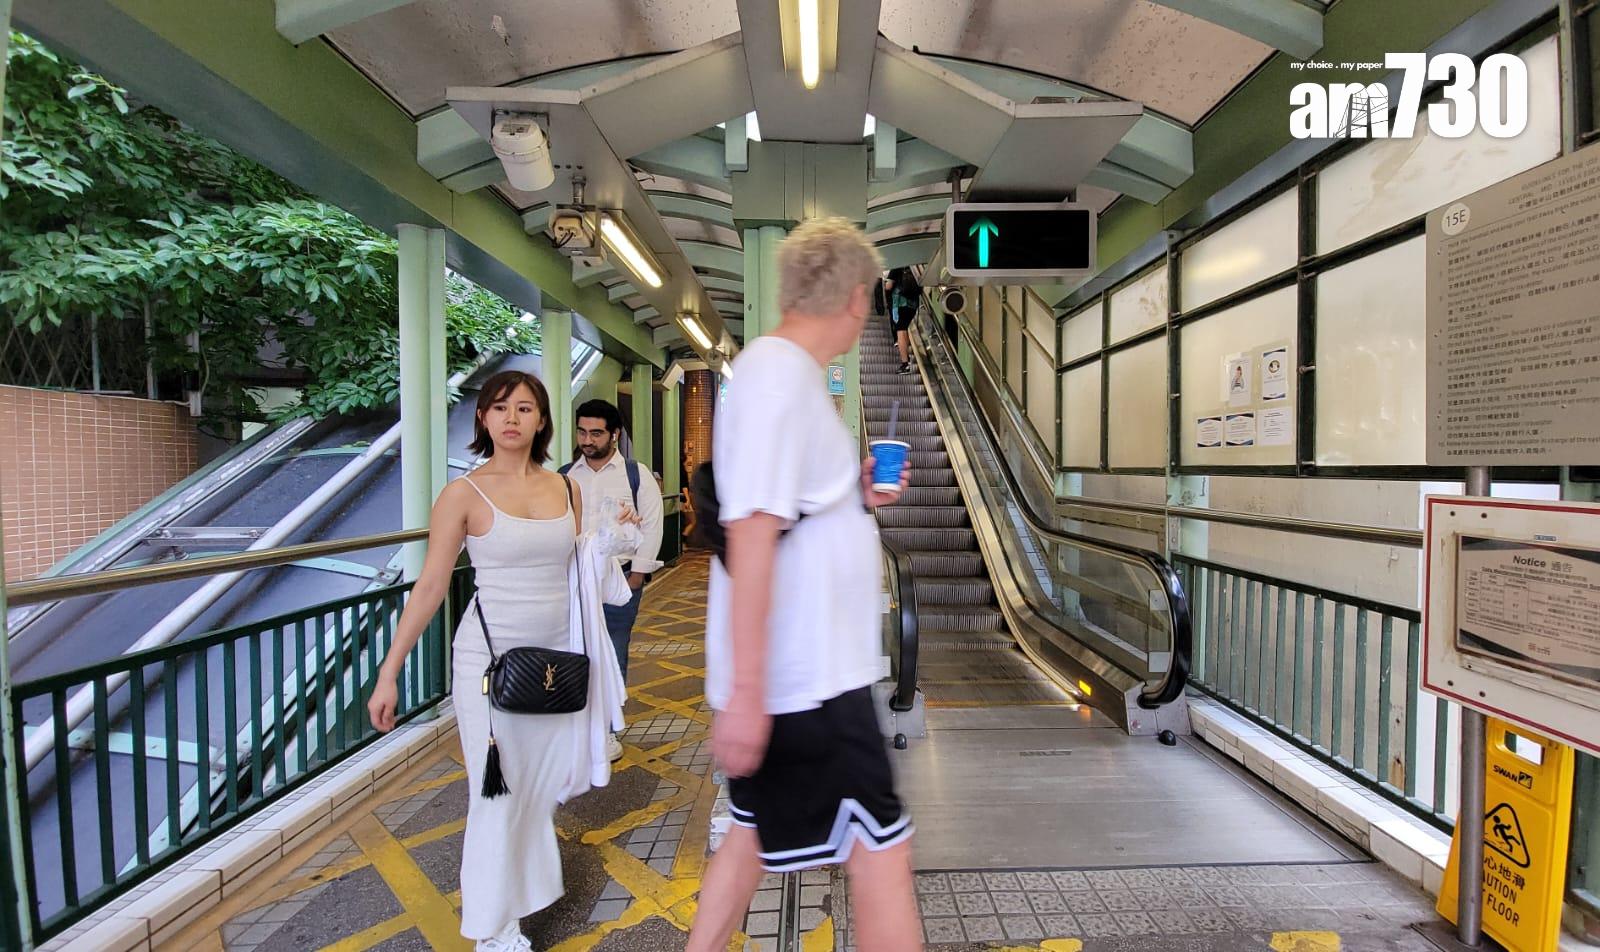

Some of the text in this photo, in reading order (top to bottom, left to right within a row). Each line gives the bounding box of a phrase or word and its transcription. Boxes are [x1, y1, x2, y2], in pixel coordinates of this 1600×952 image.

[1445, 209, 1466, 227] 15E
[1512, 555, 1546, 568] Notice
[1493, 764, 1518, 782] SWAN
[1484, 855, 1526, 891] 心地滑
[1487, 894, 1520, 927] FLOOR
